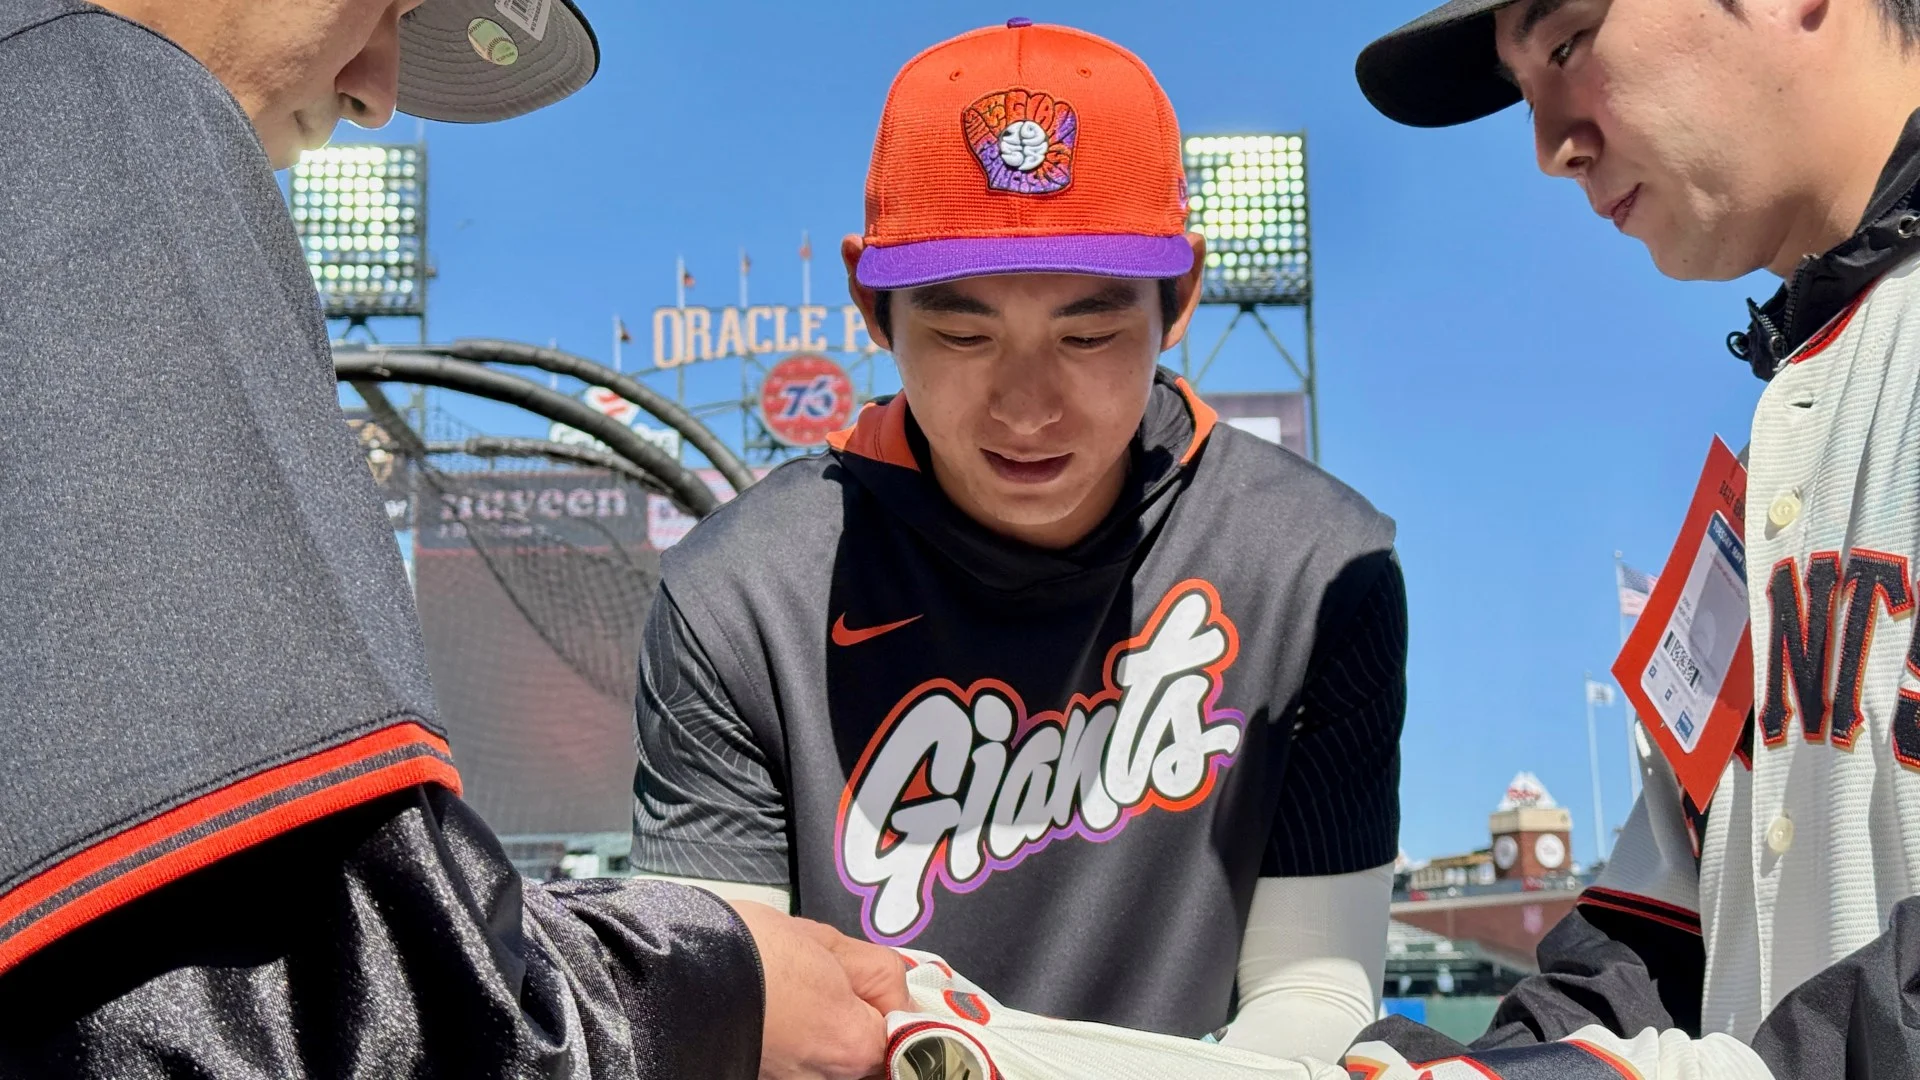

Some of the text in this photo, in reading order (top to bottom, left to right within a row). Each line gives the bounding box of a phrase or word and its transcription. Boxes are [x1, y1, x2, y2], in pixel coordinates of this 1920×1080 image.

[653, 306, 828, 369] ORACLE
[780, 375, 837, 419] 76
[838, 582, 1244, 943] Giants
